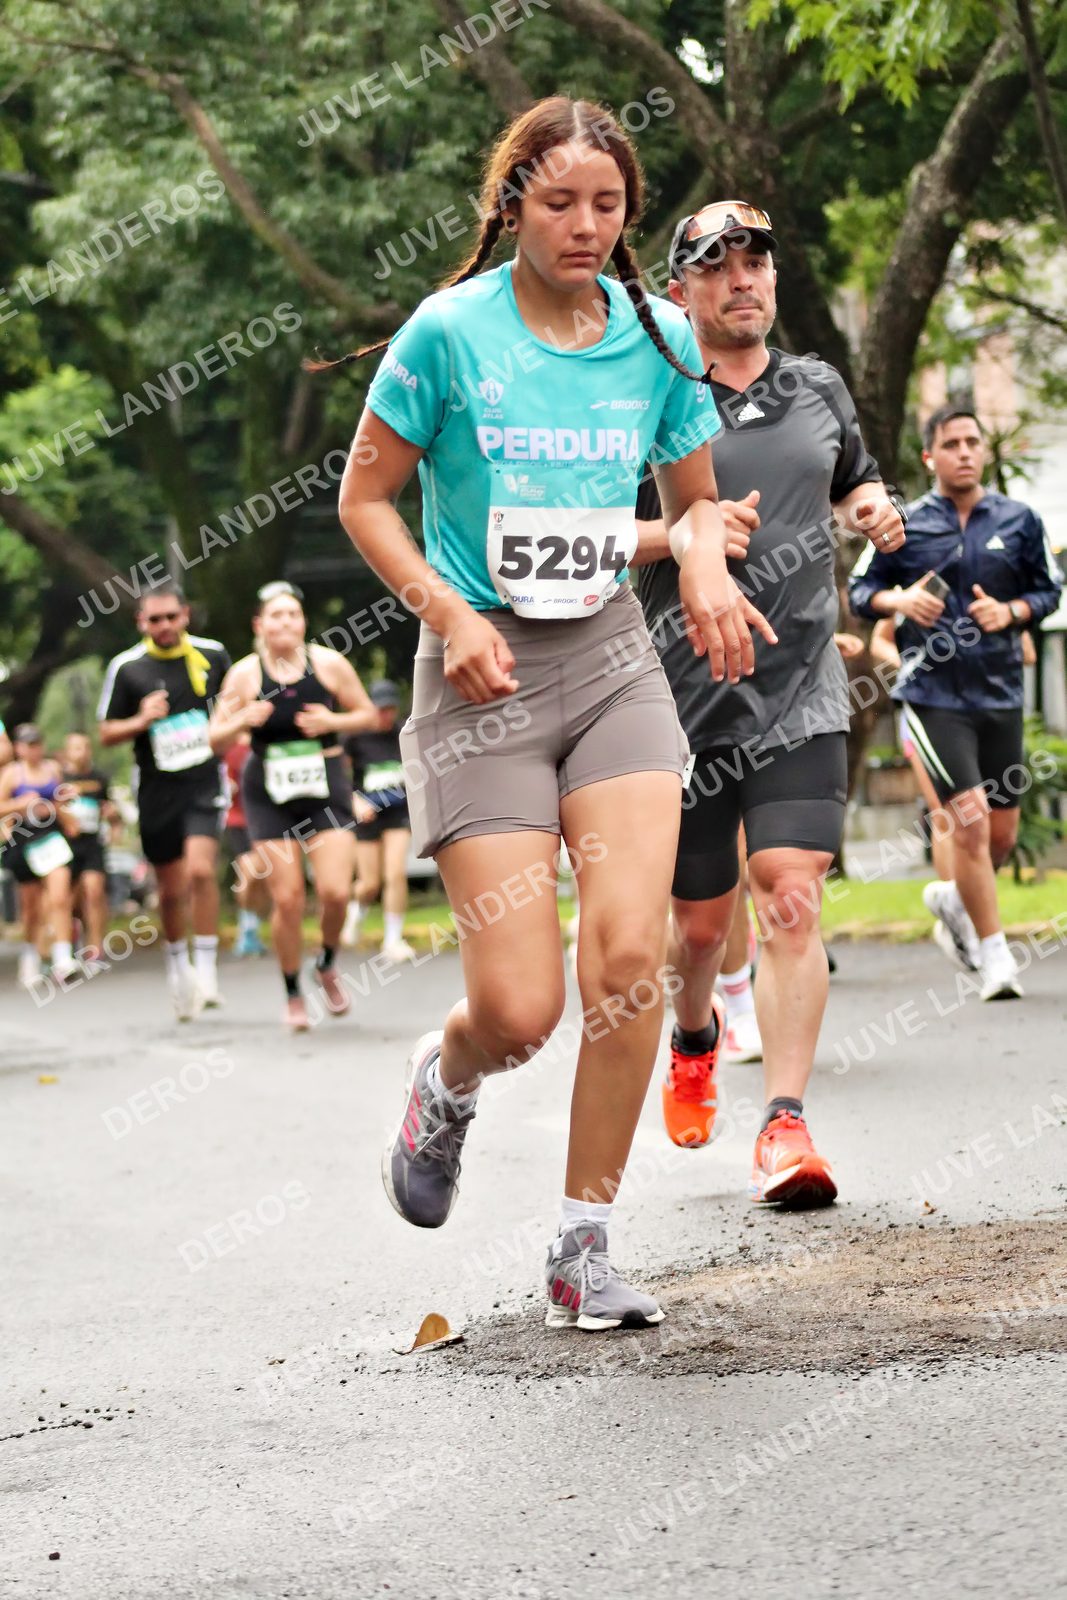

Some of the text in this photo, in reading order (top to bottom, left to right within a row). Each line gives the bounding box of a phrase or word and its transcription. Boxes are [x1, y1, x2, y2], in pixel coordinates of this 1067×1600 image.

[610, 399, 650, 410] BROOKS
[476, 426, 639, 463] PERDURA
[498, 535, 627, 581] 5294
